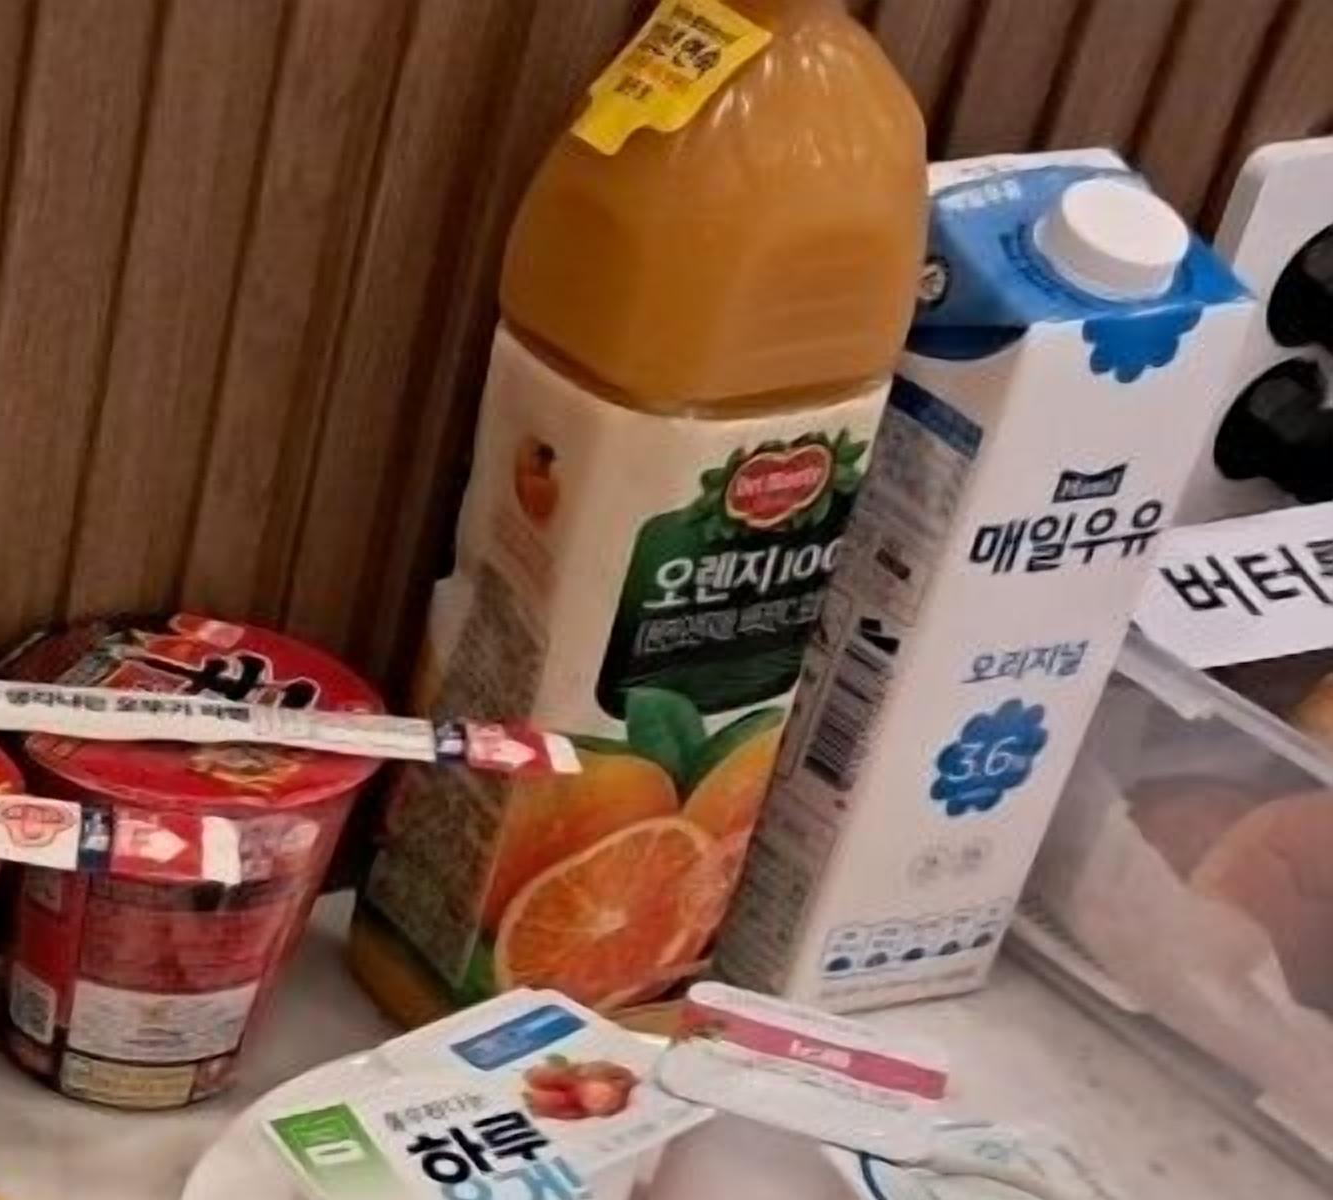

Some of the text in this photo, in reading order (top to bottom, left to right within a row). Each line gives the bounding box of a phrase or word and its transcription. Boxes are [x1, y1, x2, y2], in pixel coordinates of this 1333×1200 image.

[969, 500, 1164, 574] 매일우유
[959, 640, 1091, 685] 오리지널
[406, 1111, 551, 1184] 하루
